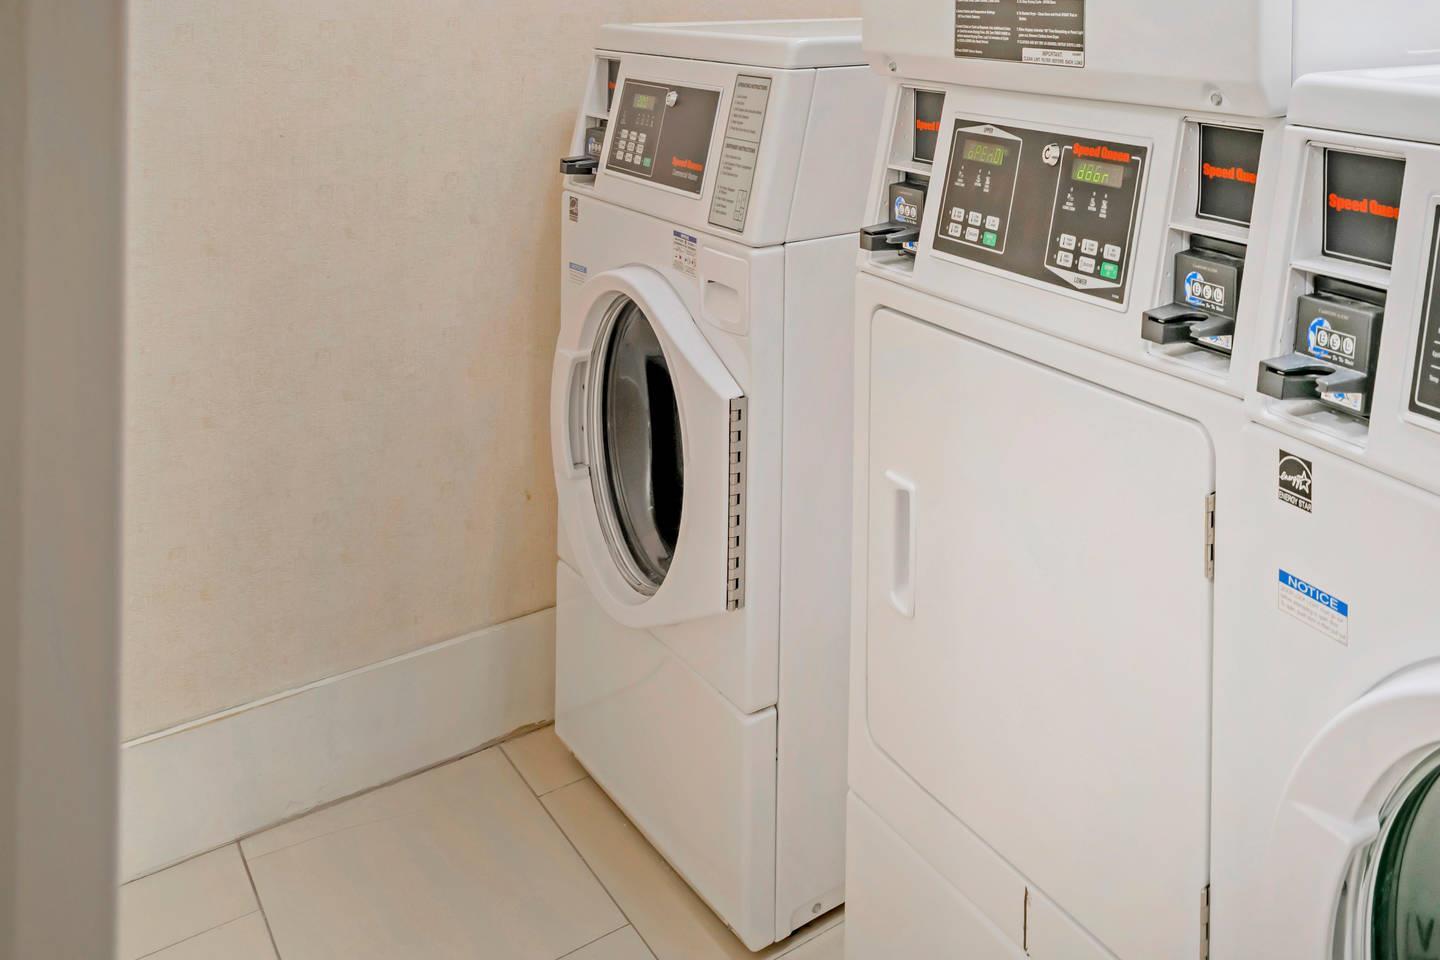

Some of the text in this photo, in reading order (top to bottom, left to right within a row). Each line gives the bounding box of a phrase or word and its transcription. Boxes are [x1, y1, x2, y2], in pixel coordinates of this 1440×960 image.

[1073, 143, 1100, 158] Speed
[1203, 163, 1235, 179] Speed
[1328, 193, 1367, 213] Speed
[1288, 575, 1339, 611] NOTICE
